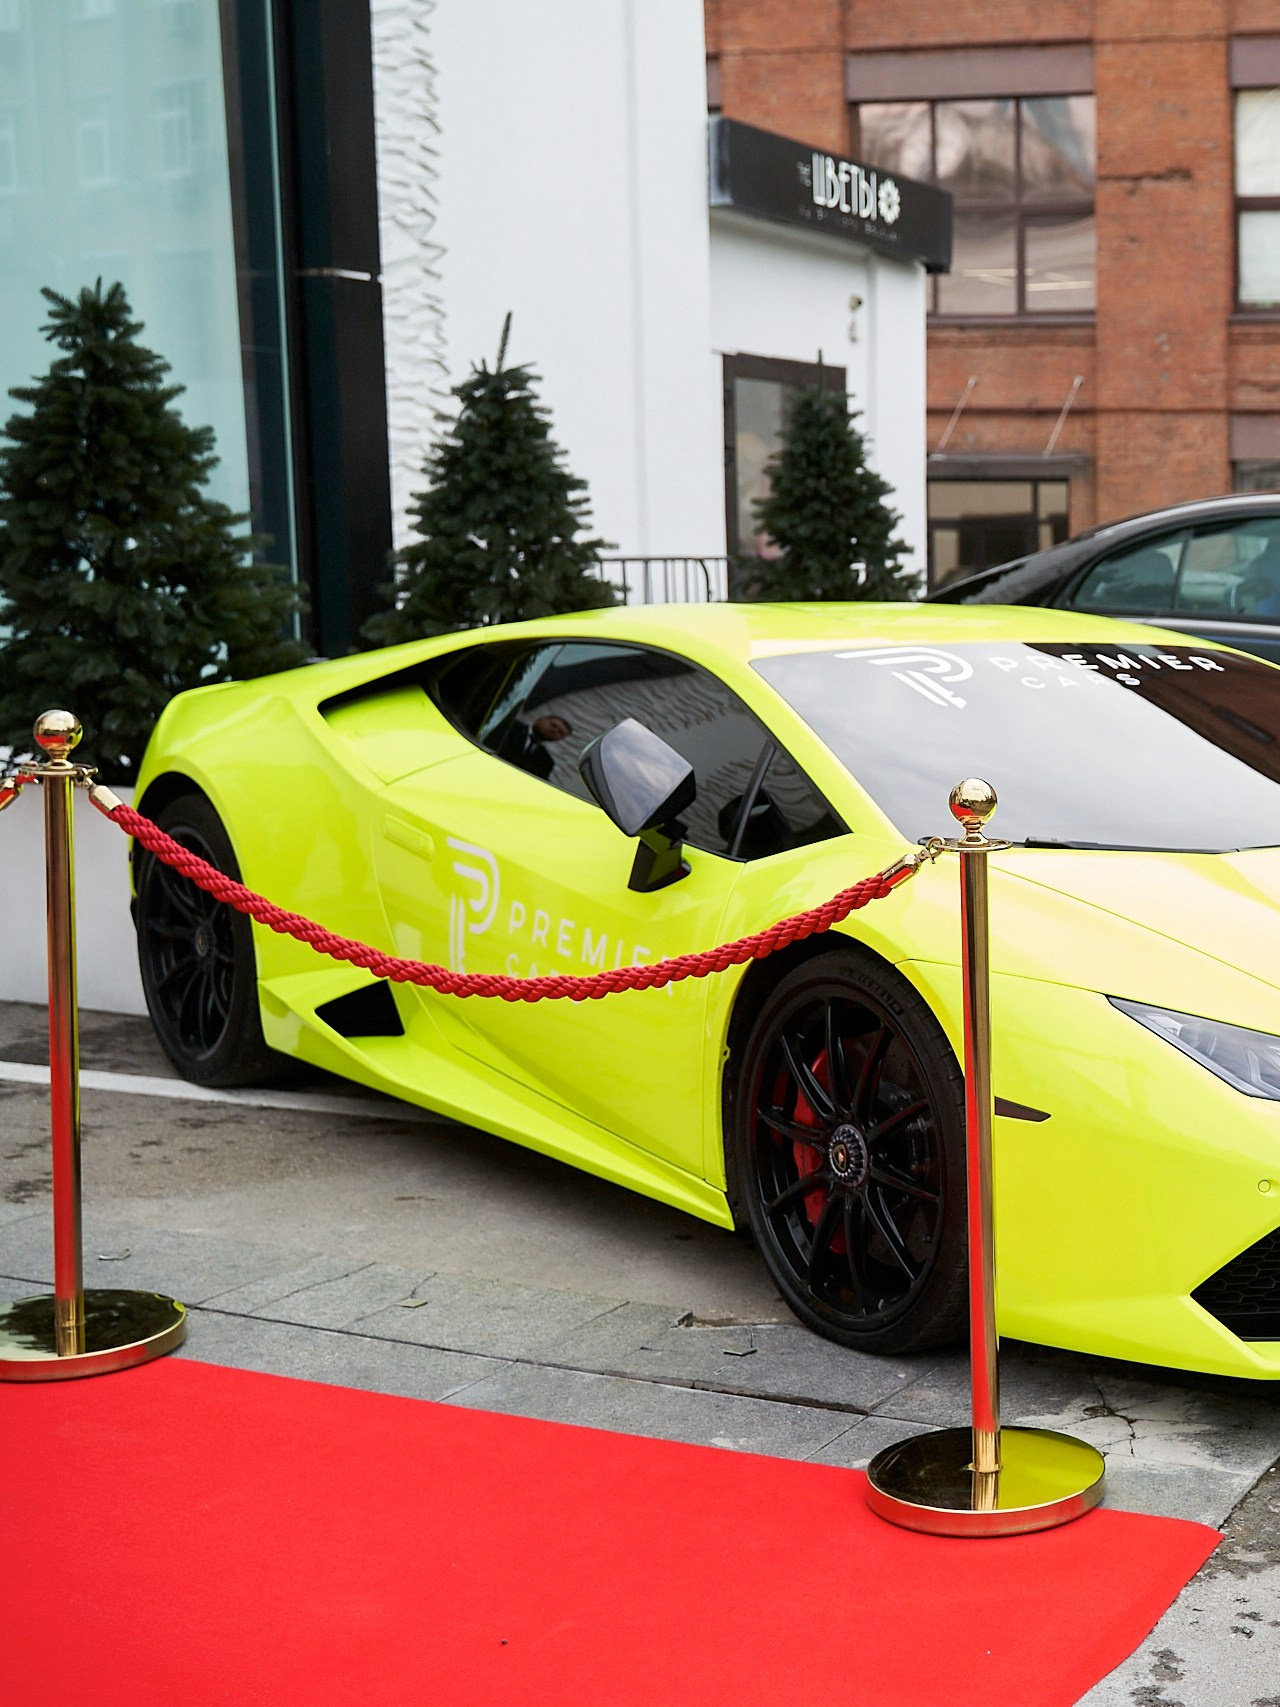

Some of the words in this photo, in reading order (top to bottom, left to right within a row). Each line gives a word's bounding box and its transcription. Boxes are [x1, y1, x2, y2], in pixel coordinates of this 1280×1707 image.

[811, 152, 878, 221] ЦВЕТЫ
[988, 653, 1226, 673] PREMIER
[1020, 673, 1142, 690] CARS
